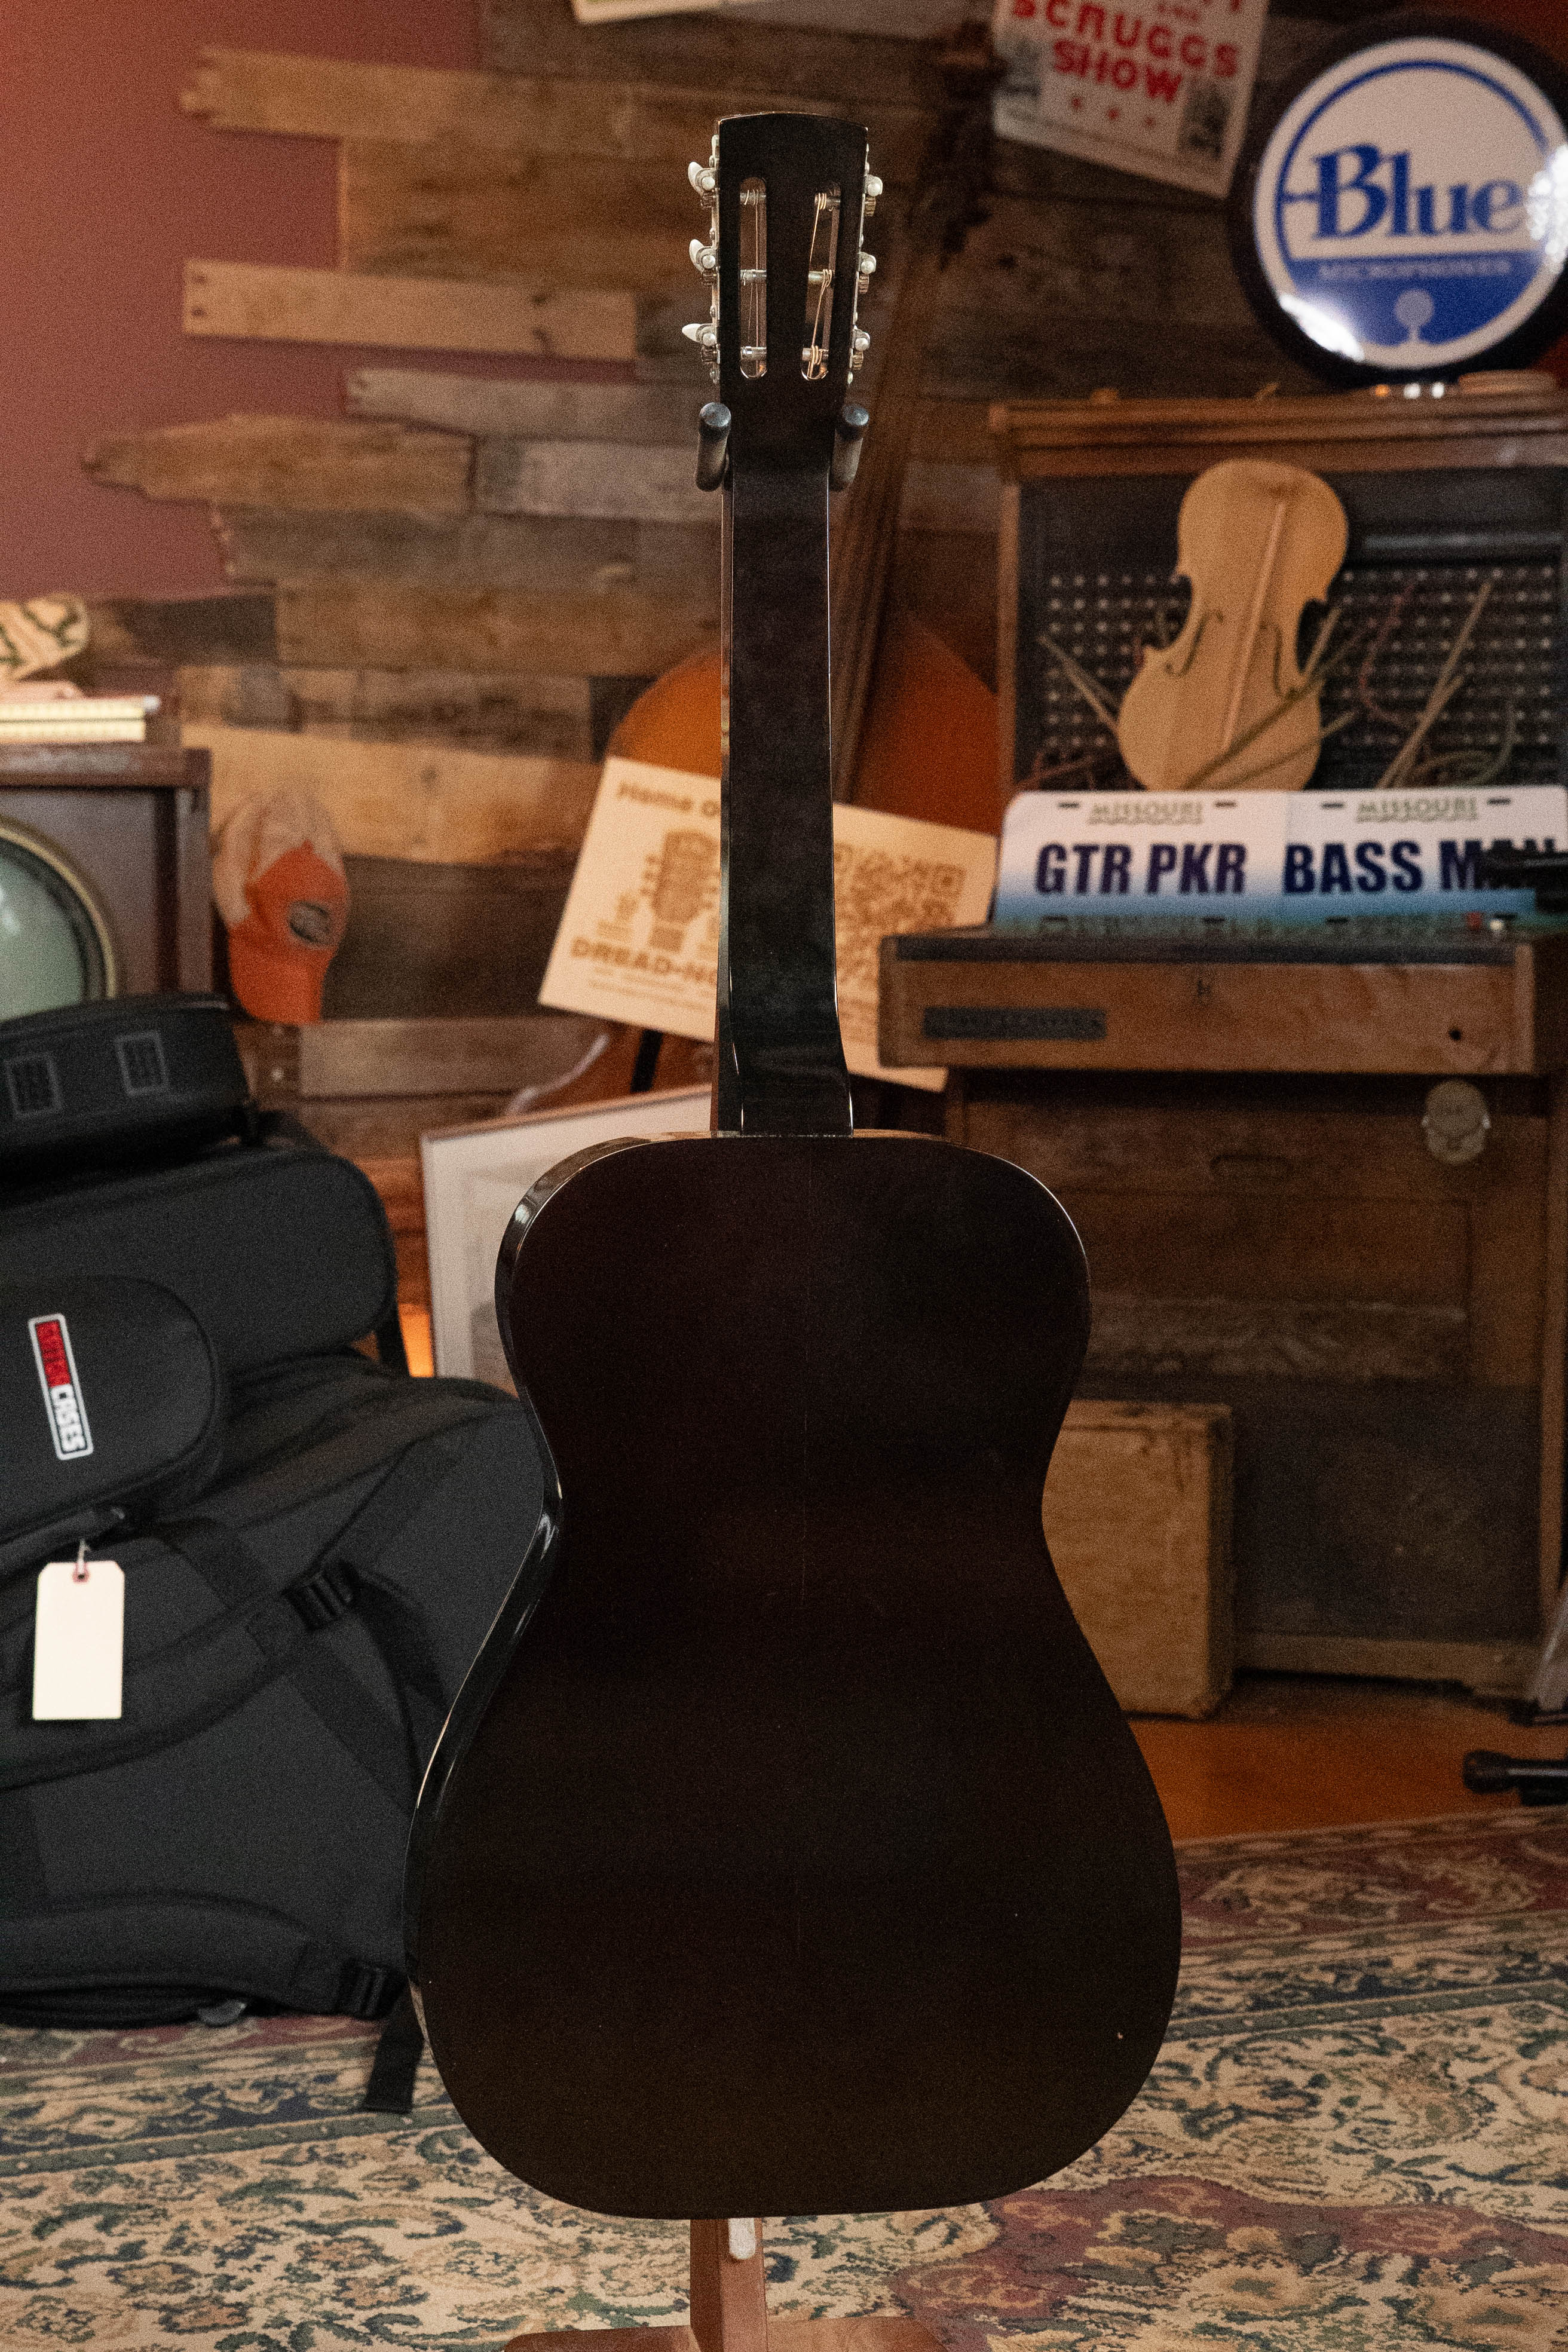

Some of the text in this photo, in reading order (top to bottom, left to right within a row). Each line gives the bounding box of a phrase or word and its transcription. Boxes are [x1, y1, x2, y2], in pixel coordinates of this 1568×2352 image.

[1054, 39, 1182, 103] SHOW
[1312, 143, 1524, 239] Blue
[1089, 801, 1203, 825] MISSOURI
[1356, 797, 1478, 822] MISSOURI
[1036, 843, 1247, 895] GTR PKR
[1284, 841, 1423, 892] BASS
[50, 1384, 86, 1451] CASES
